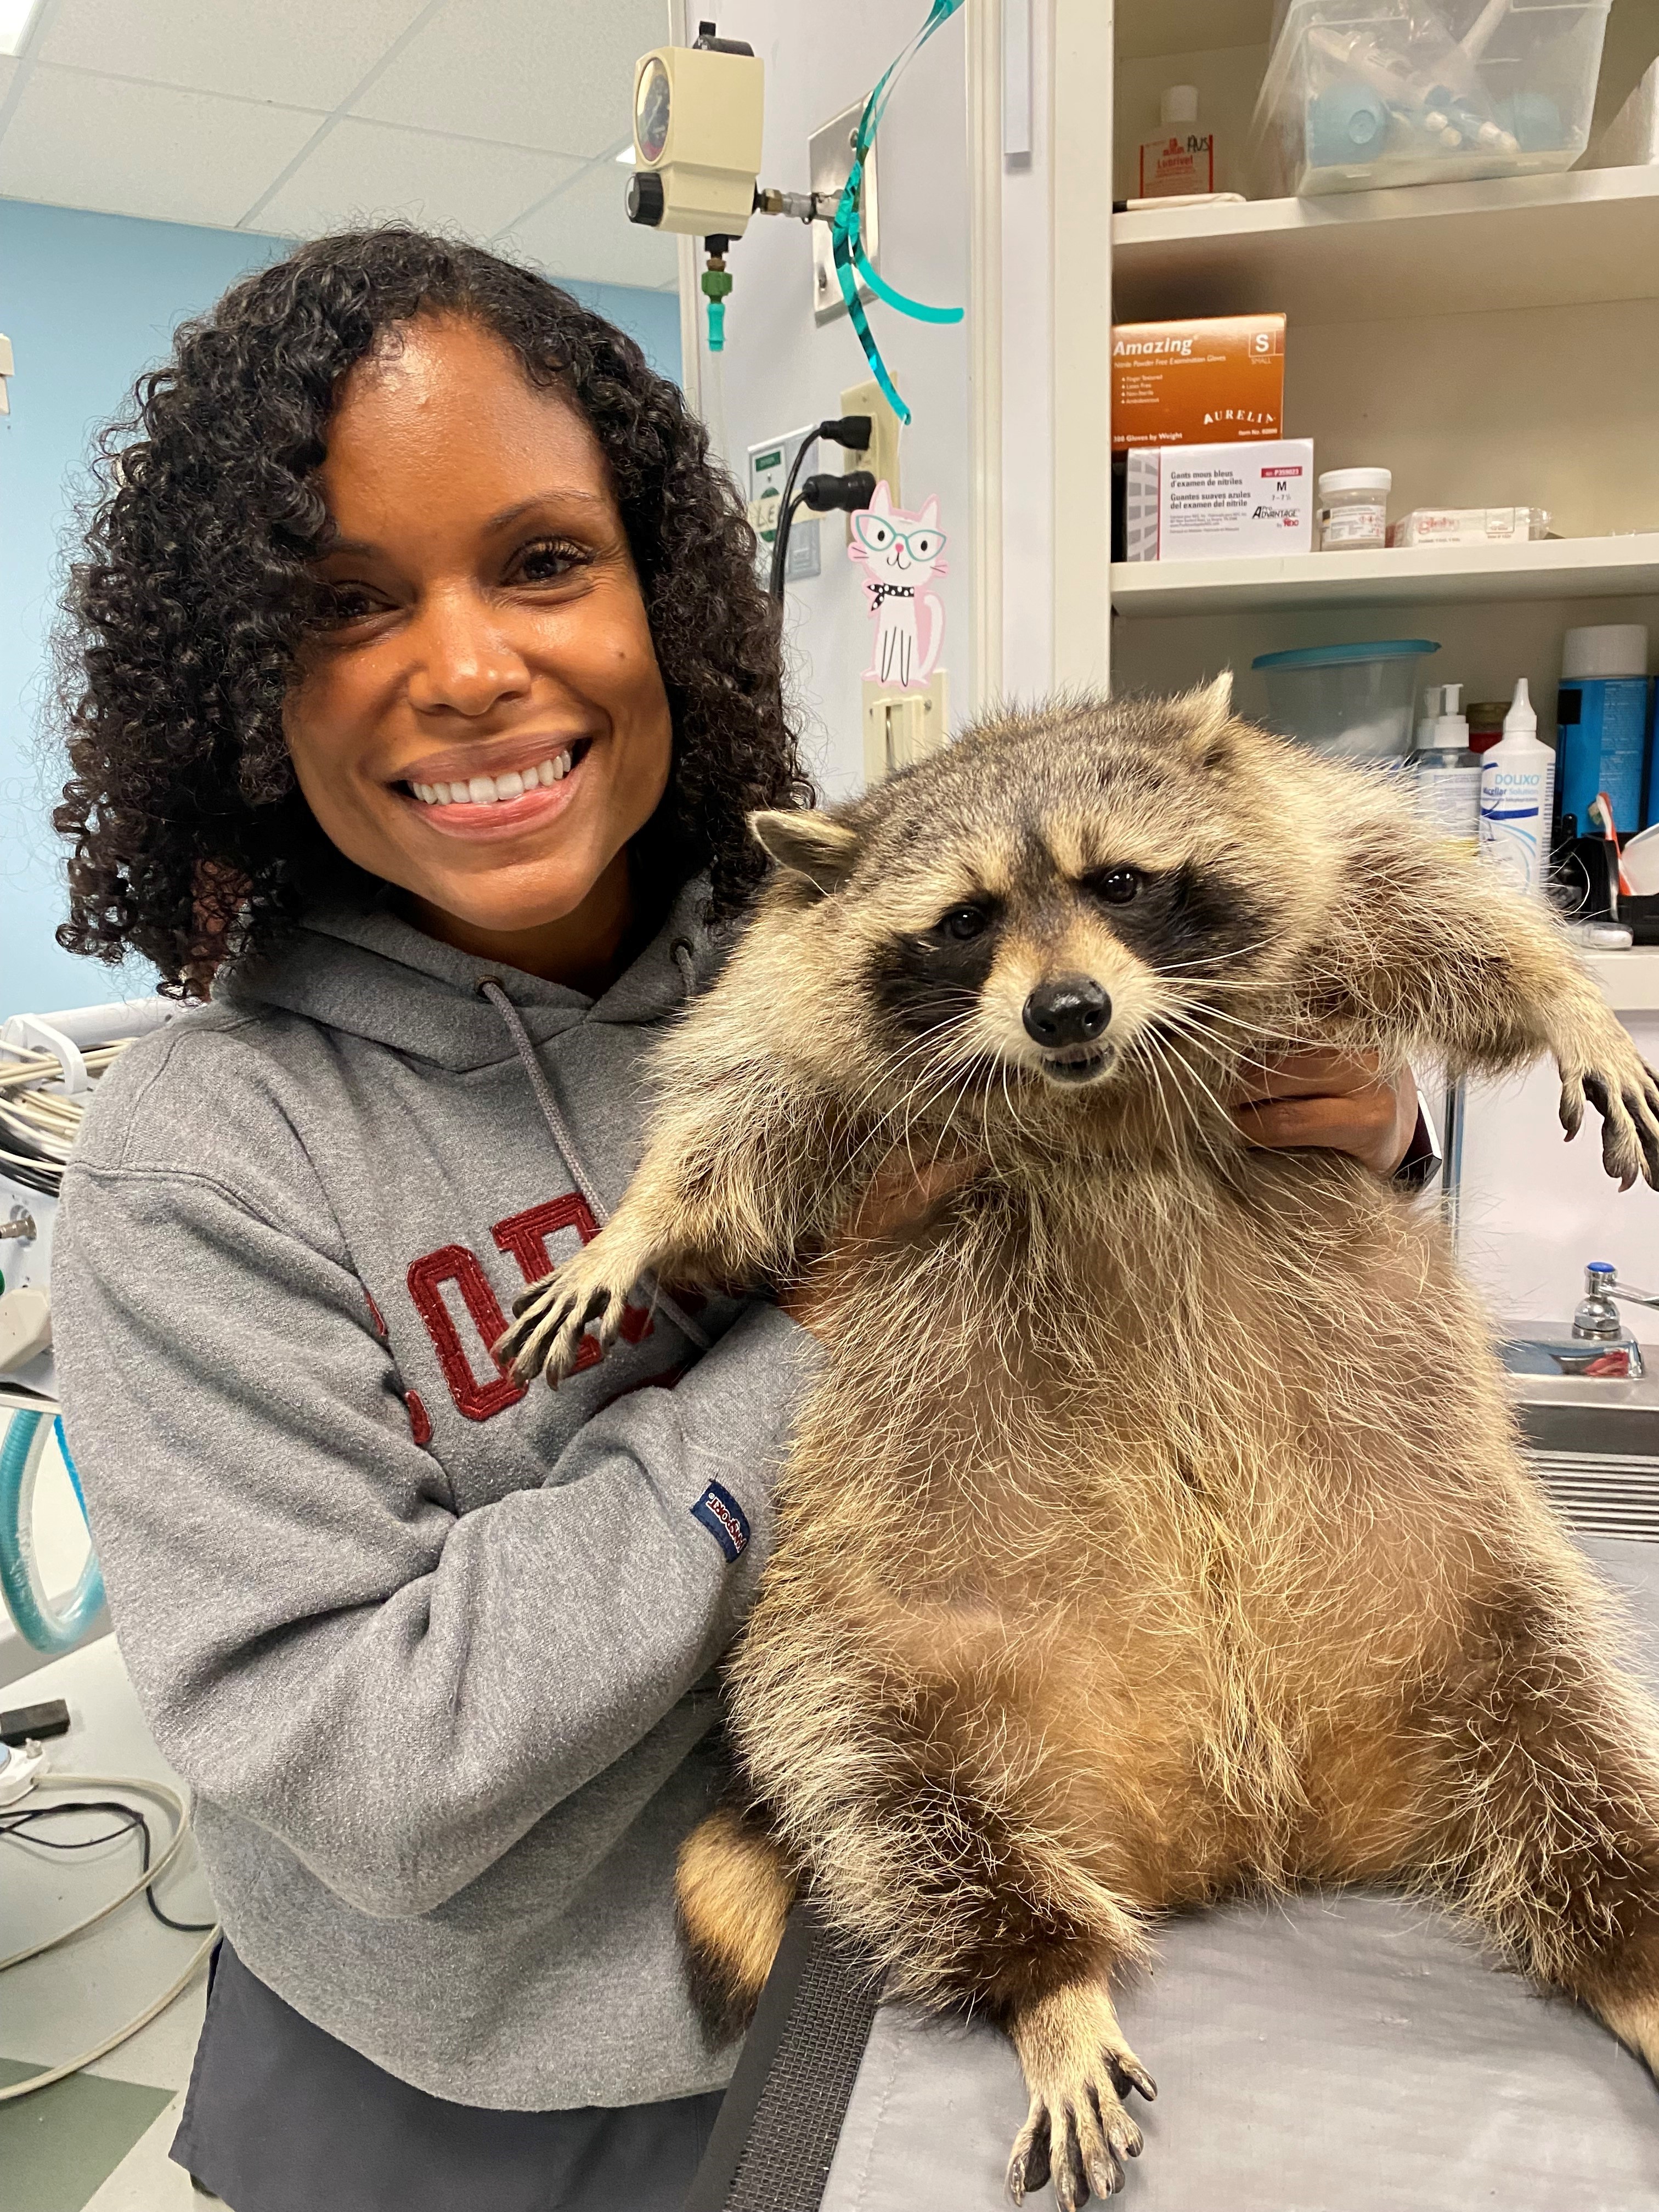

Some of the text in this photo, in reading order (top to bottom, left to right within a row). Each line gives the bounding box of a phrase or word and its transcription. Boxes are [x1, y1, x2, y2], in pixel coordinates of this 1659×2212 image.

[1113, 337, 1193, 356] Amazing
[1255, 334, 1269, 353] S
[1203, 409, 1275, 425] AURELIA
[1171, 471, 1191, 479] Gants
[1214, 470, 1233, 478] bleus
[1277, 481, 1286, 491] M
[1171, 493, 1200, 501] Guantes
[1495, 774, 1541, 786] DOUXO
